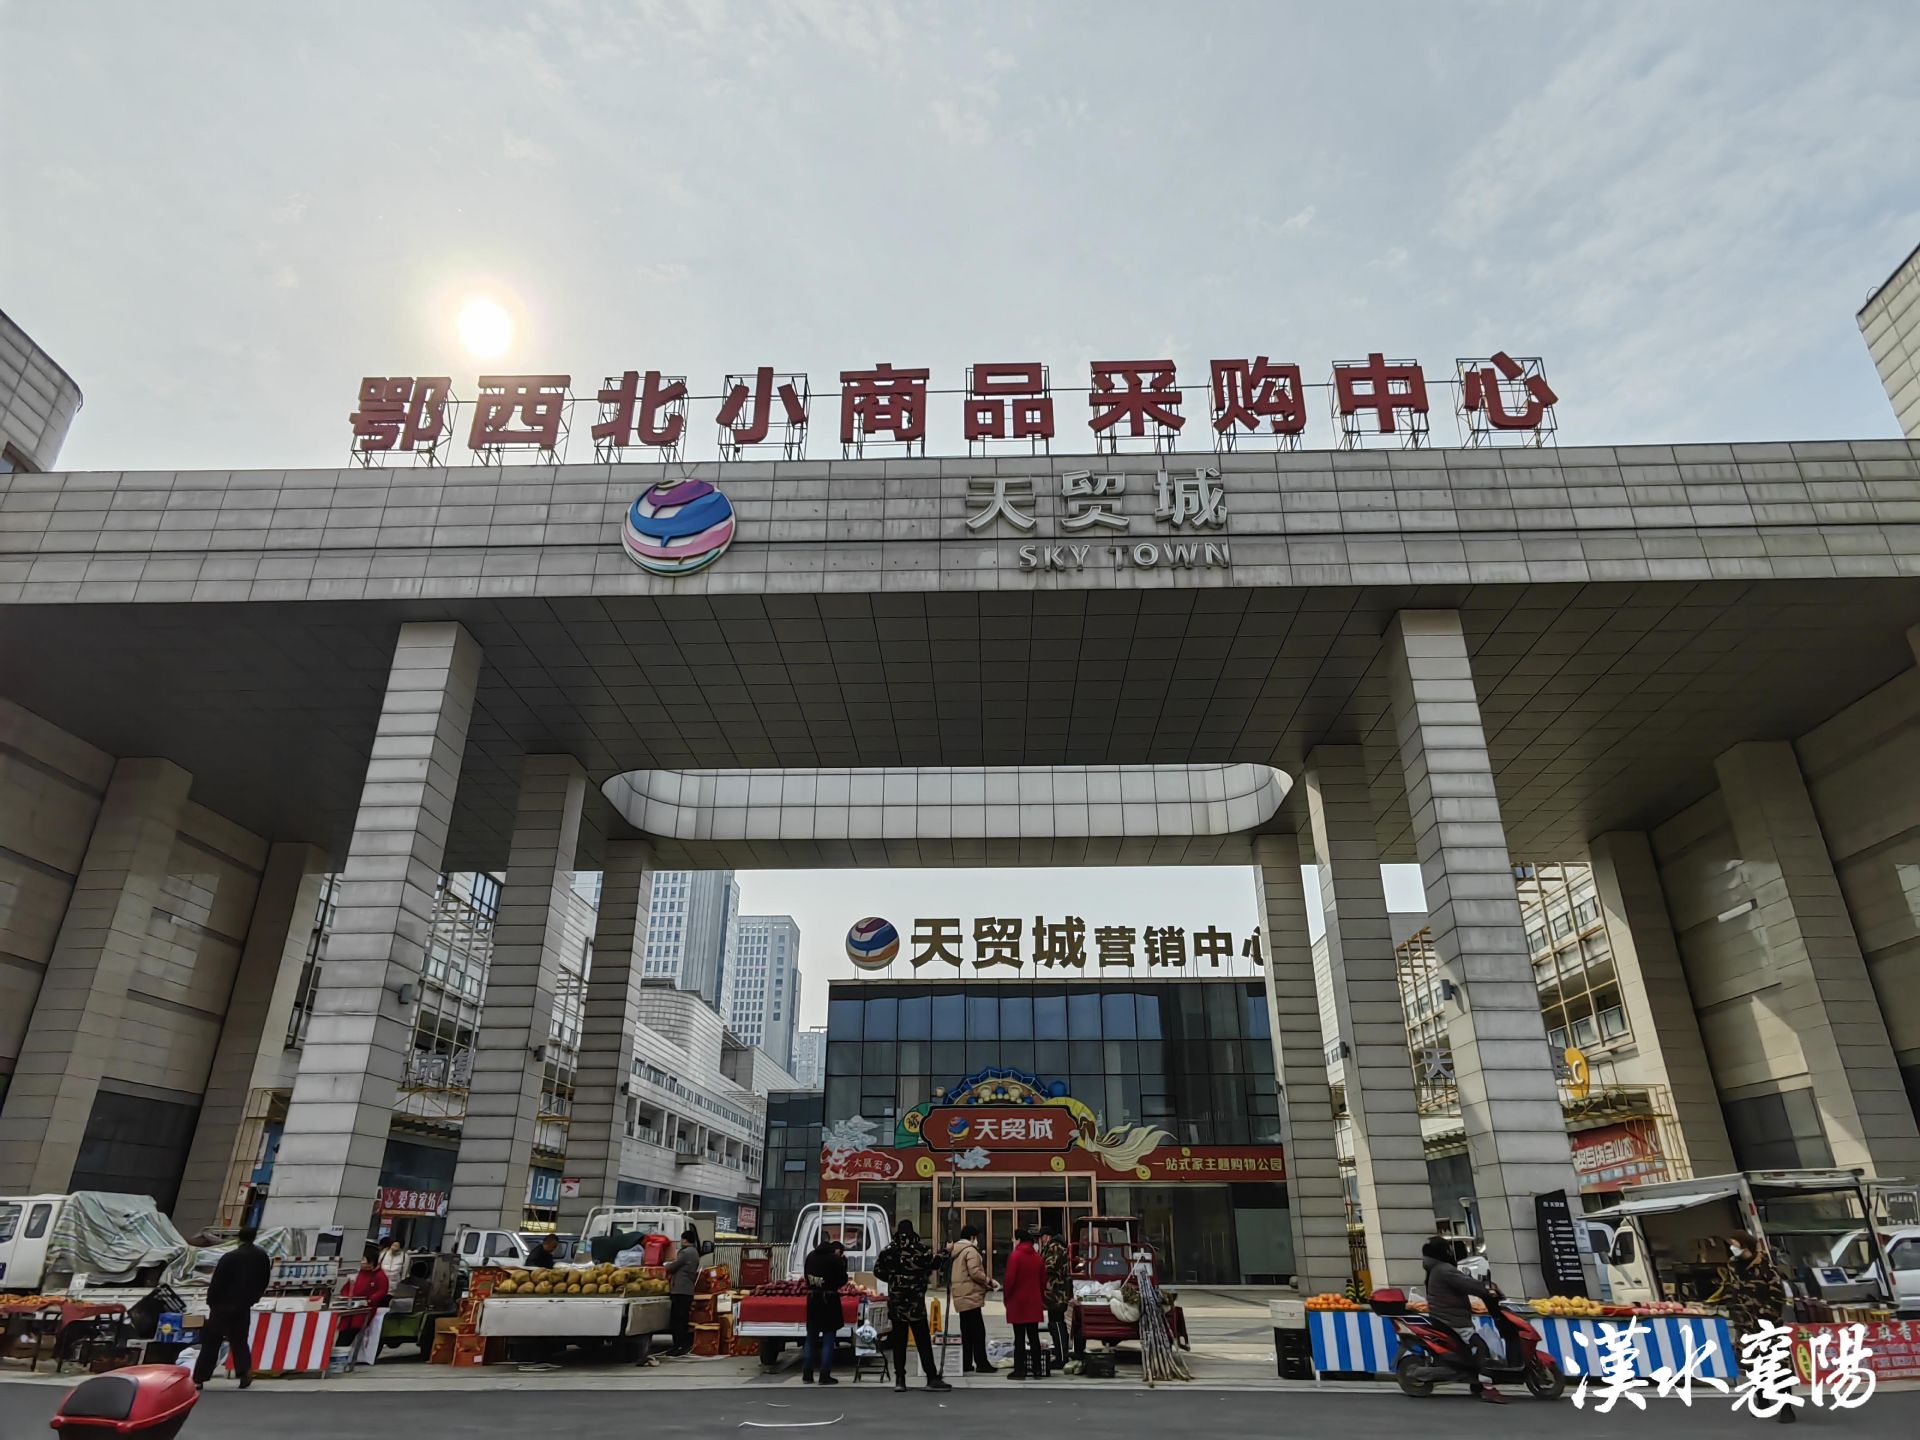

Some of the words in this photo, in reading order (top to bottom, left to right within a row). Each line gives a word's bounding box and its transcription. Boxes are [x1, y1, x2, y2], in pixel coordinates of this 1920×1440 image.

[349, 351, 1558, 451] 鄂西北小商品采购中心
[966, 468, 1228, 532] 天贸城
[1018, 543, 1090, 572] SKY
[1108, 541, 1229, 570] TOWN
[974, 1117, 1053, 1140] 天贸城
